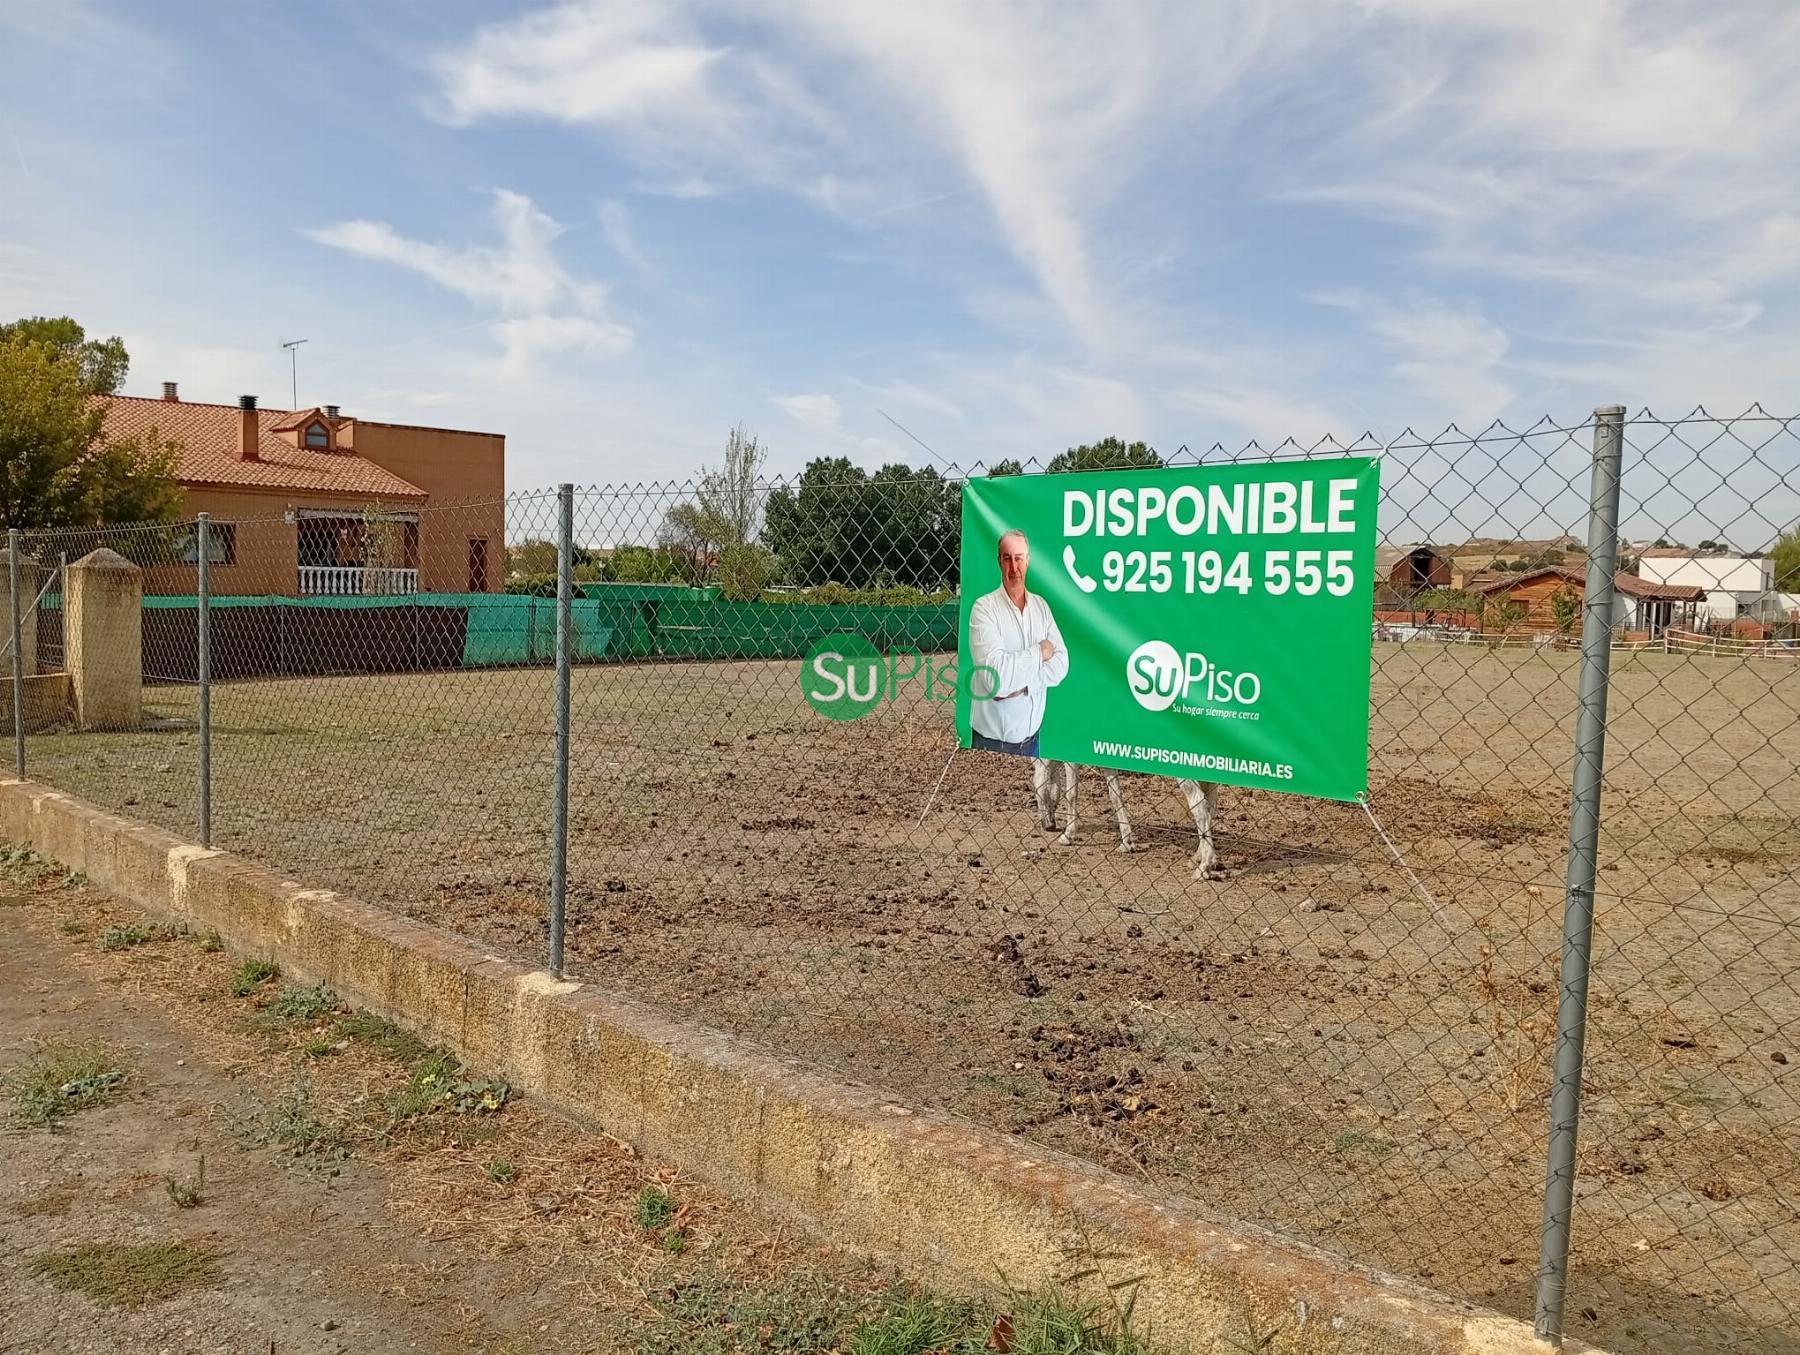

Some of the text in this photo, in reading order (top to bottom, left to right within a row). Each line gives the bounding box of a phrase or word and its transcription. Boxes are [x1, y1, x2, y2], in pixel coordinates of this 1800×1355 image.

[1062, 478, 1358, 537] DISPONIBLE
[1102, 550, 1354, 597] 925 194 555
[1134, 652, 1261, 705] SuPiso
[1172, 703, 1260, 720] Su hogar siempre cerca
[1092, 740, 1294, 780] WWW.SUPISOINMOBILIARIA.ES
